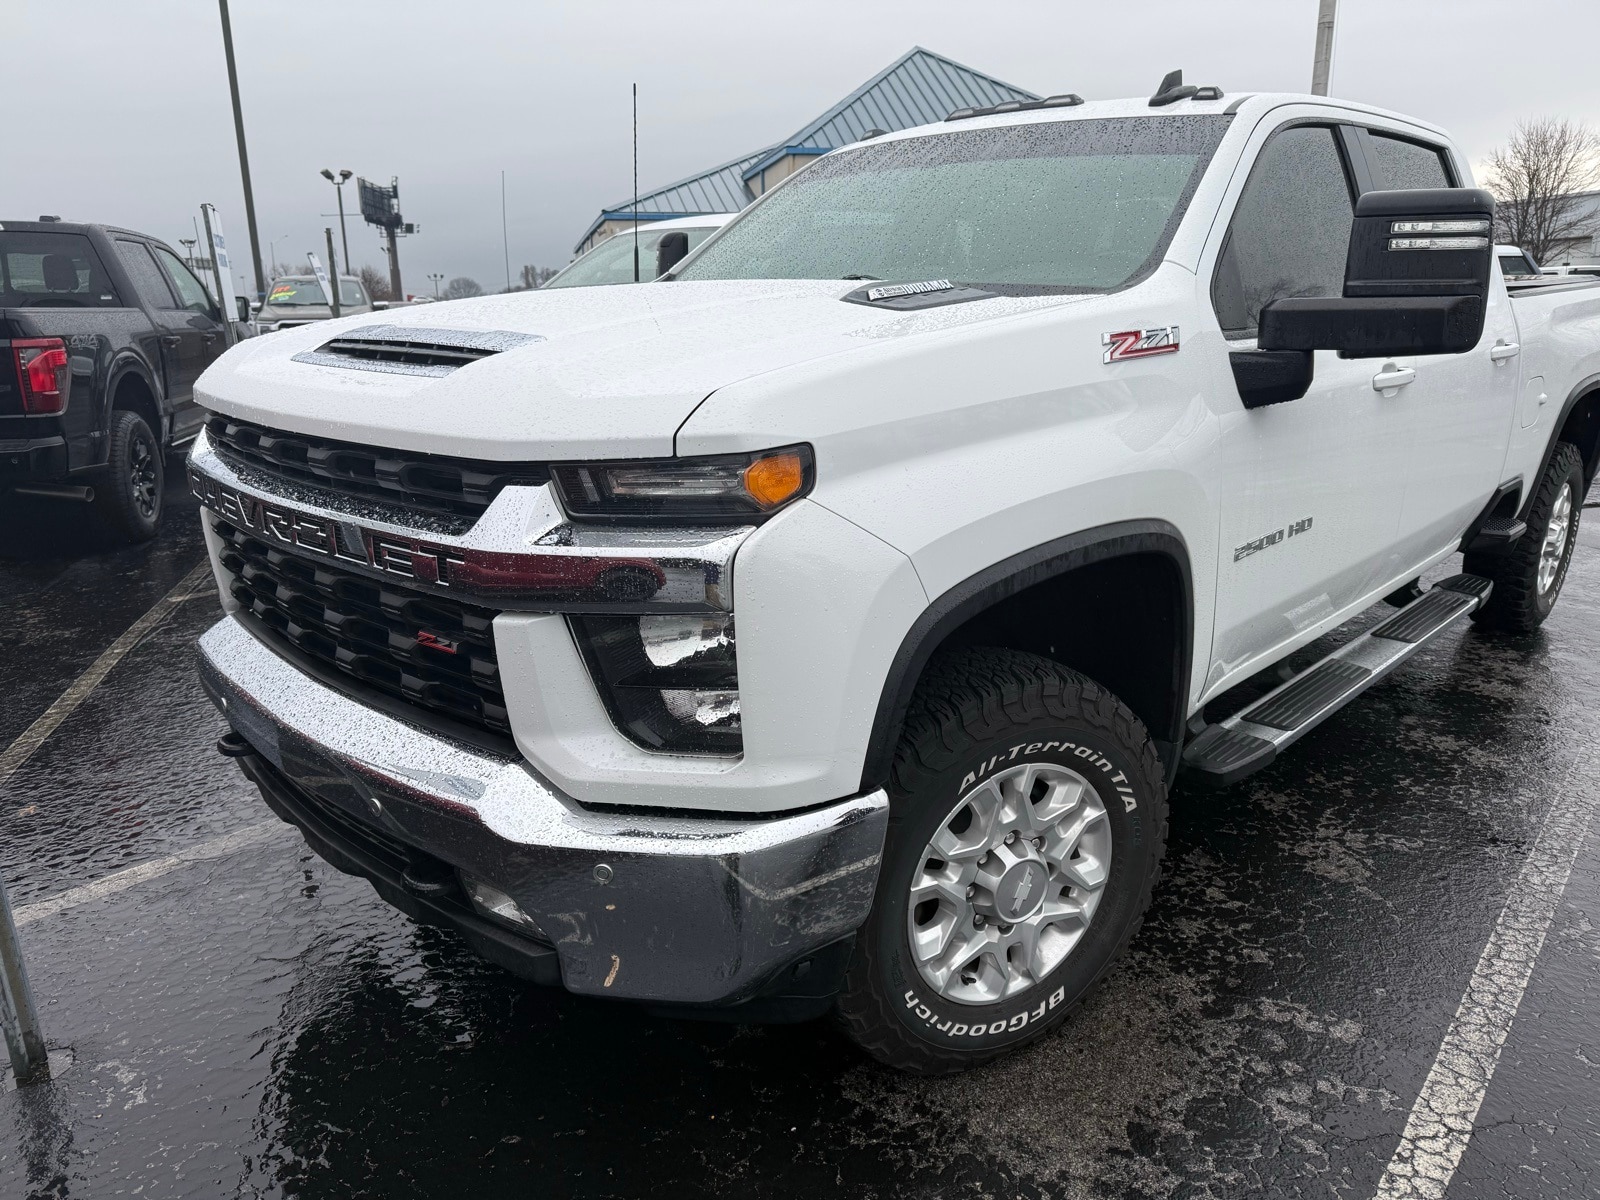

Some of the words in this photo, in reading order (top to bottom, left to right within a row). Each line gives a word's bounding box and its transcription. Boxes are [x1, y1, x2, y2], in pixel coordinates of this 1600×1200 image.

[903, 279, 955, 295] DURAMAX
[1101, 325, 1180, 364] Z71
[187, 472, 465, 587] CHEVROLET
[1233, 529, 1285, 563] 2500
[1287, 516, 1313, 539] HD
[957, 741, 1113, 796] All-Terrain
[1110, 769, 1138, 814] T/A
[903, 985, 1066, 1037] BFGoodrich
